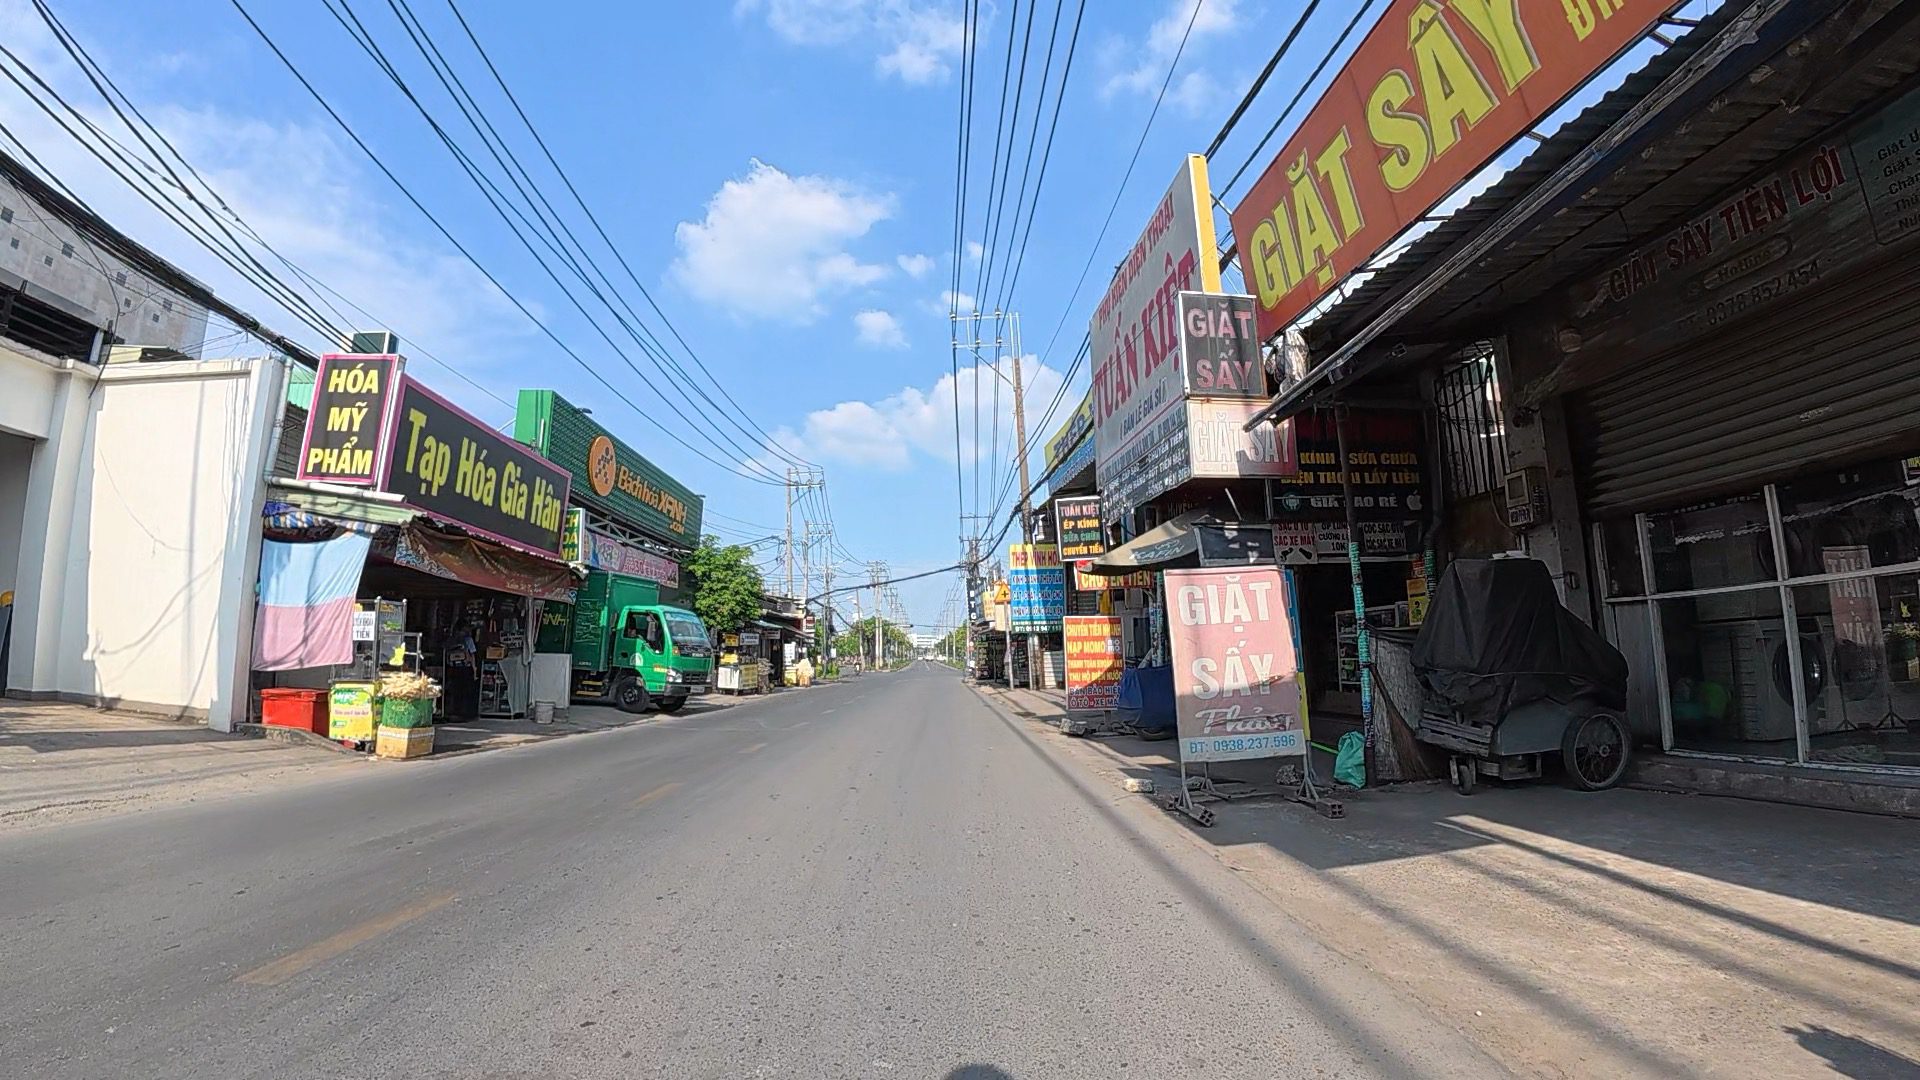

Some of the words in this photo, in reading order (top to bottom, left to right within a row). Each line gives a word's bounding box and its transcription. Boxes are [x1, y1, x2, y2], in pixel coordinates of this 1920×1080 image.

[1790, 145, 1846, 207] LỢI
[1251, 125, 1365, 311] GIẶT
[1094, 312, 1138, 429] TUẤN
[1141, 247, 1196, 379] KIỆT
[1187, 301, 1251, 345] GIẶT
[328, 363, 378, 394] HÓA
[1196, 350, 1252, 390] SẤY
[327, 401, 369, 432] MỸ
[306, 436, 373, 475] PHẨM
[1193, 411, 1244, 473] GIẶT
[1300, 449, 1336, 465] KÍNH
[1348, 450, 1378, 465] SỬA
[1380, 450, 1418, 465] CHỮA
[405, 407, 451, 497] Tạp
[455, 437, 497, 508] Hóa
[500, 461, 529, 521] Gia
[530, 476, 561, 533] Hân
[658, 490, 687, 525] XANH
[1060, 502, 1081, 517] TUẤN
[1083, 502, 1100, 518] KIỆT
[1378, 492, 1399, 508] RẺ
[1063, 518, 1075, 530] ÉP
[1077, 518, 1099, 528] KÍNH
[1063, 543, 1088, 556] CHUYỂN
[1289, 535, 1299, 547] XE
[1177, 576, 1273, 633] GIẶT
[1066, 619, 1089, 637] CHUYỂN
[1089, 620, 1102, 637] TIỀN
[1067, 641, 1082, 657] NẠP
[1083, 641, 1106, 653] MOMO
[1068, 672, 1082, 681] THU
[1107, 669, 1122, 681] NƯỚC
[1192, 640, 1274, 700] SẤY
[1069, 684, 1086, 695] BÁN
[1087, 682, 1103, 695] BẢO
[1094, 698, 1105, 707] XE
[1190, 741, 1209, 754] ĐT:
[1213, 734, 1296, 753] 0938.237.596
